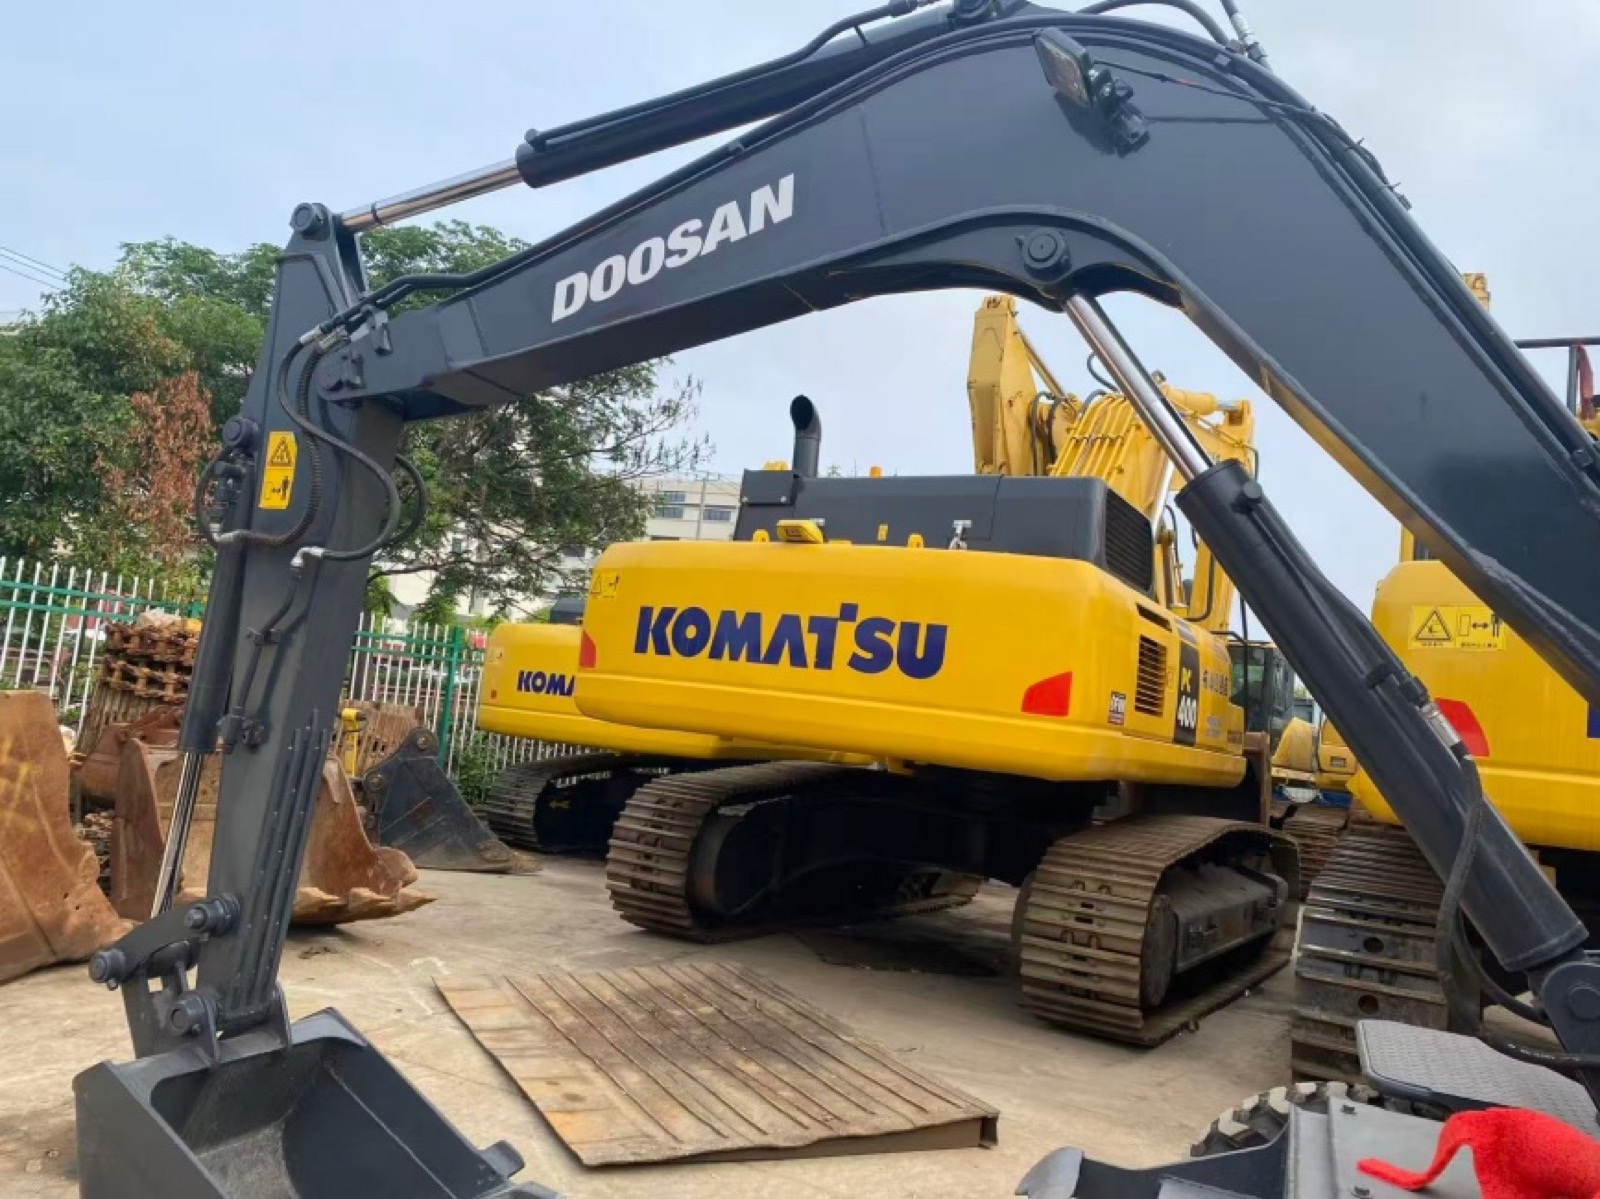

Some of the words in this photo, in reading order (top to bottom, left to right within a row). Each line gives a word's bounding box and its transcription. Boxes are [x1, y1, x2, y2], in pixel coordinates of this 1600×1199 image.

[551, 173, 795, 324] DOOSAN
[634, 602, 948, 680] KOMATSU
[1177, 695, 1198, 730] 400
